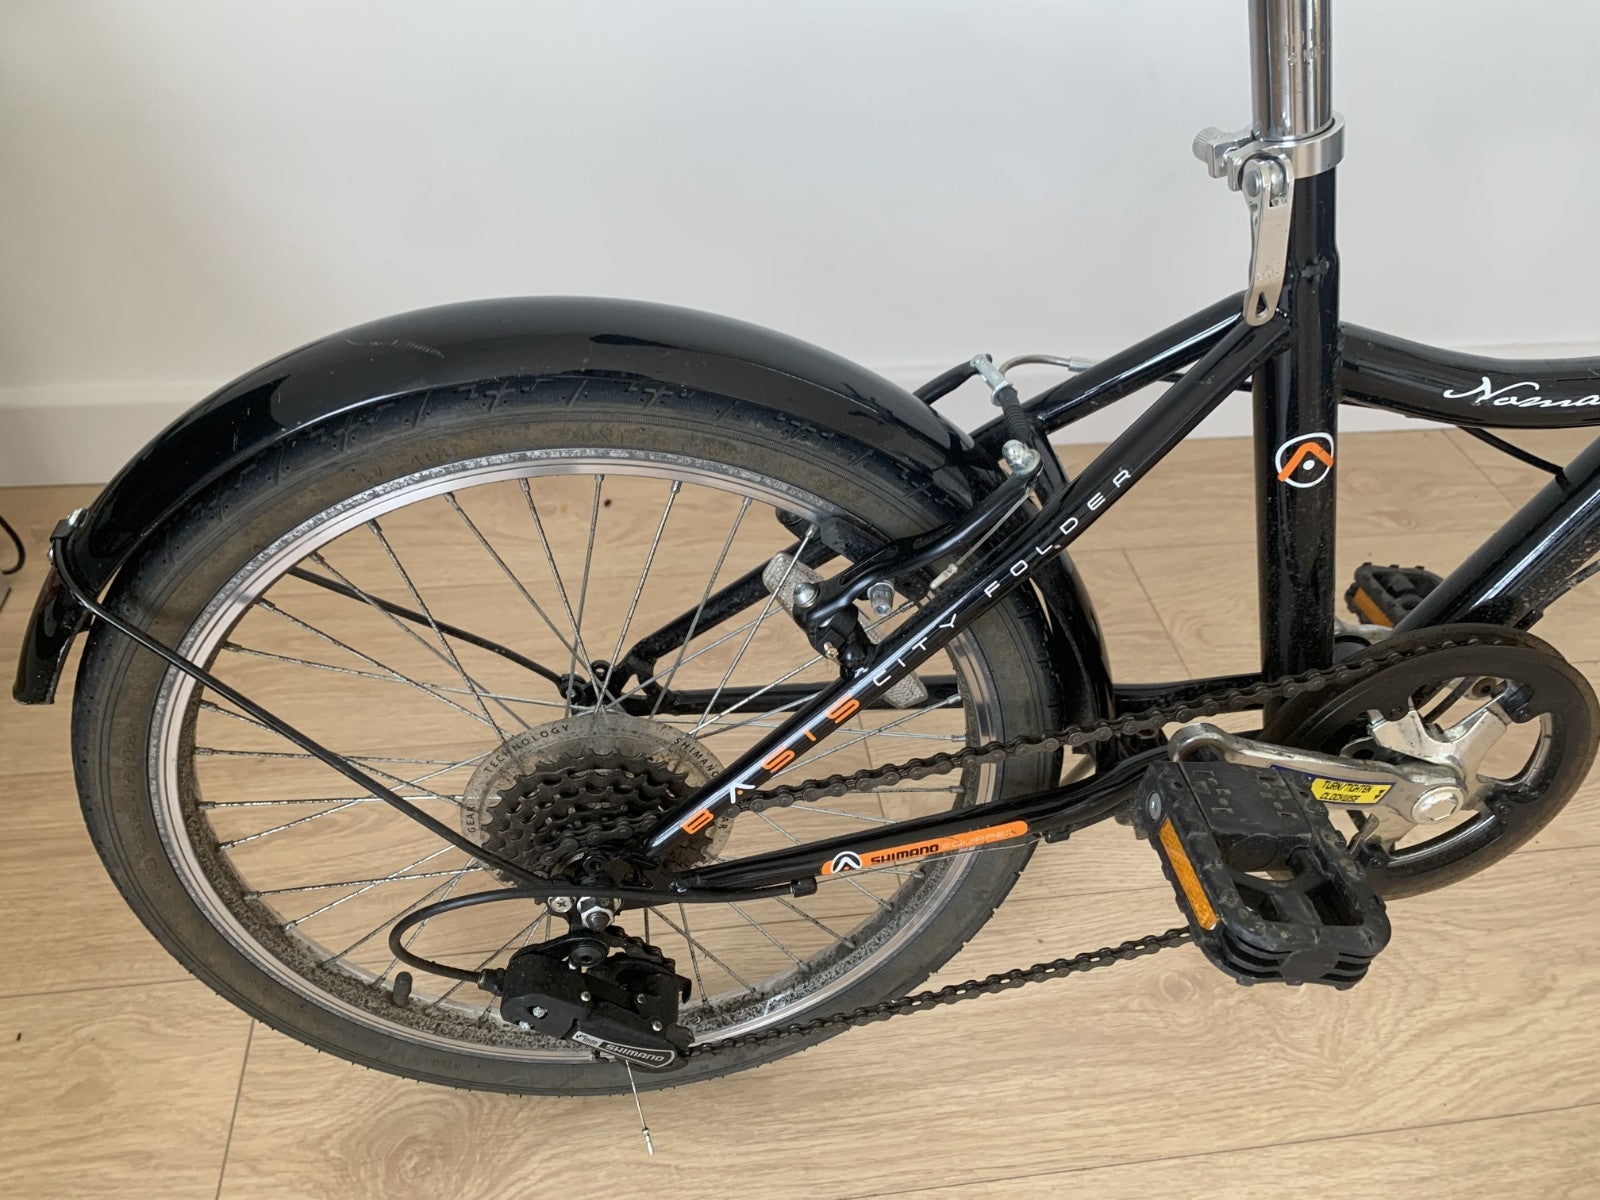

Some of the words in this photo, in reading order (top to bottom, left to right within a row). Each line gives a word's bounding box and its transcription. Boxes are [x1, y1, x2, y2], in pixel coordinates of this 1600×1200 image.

[872, 613, 957, 687] CITY
[984, 469, 1132, 598] FOLDER
[673, 737, 721, 778] SHIMANO
[467, 804, 477, 834] GEAR
[483, 723, 571, 774] TECHNOLOGY
[870, 844, 940, 866] SHIMANO
[605, 1043, 666, 1063] SHIMANO
